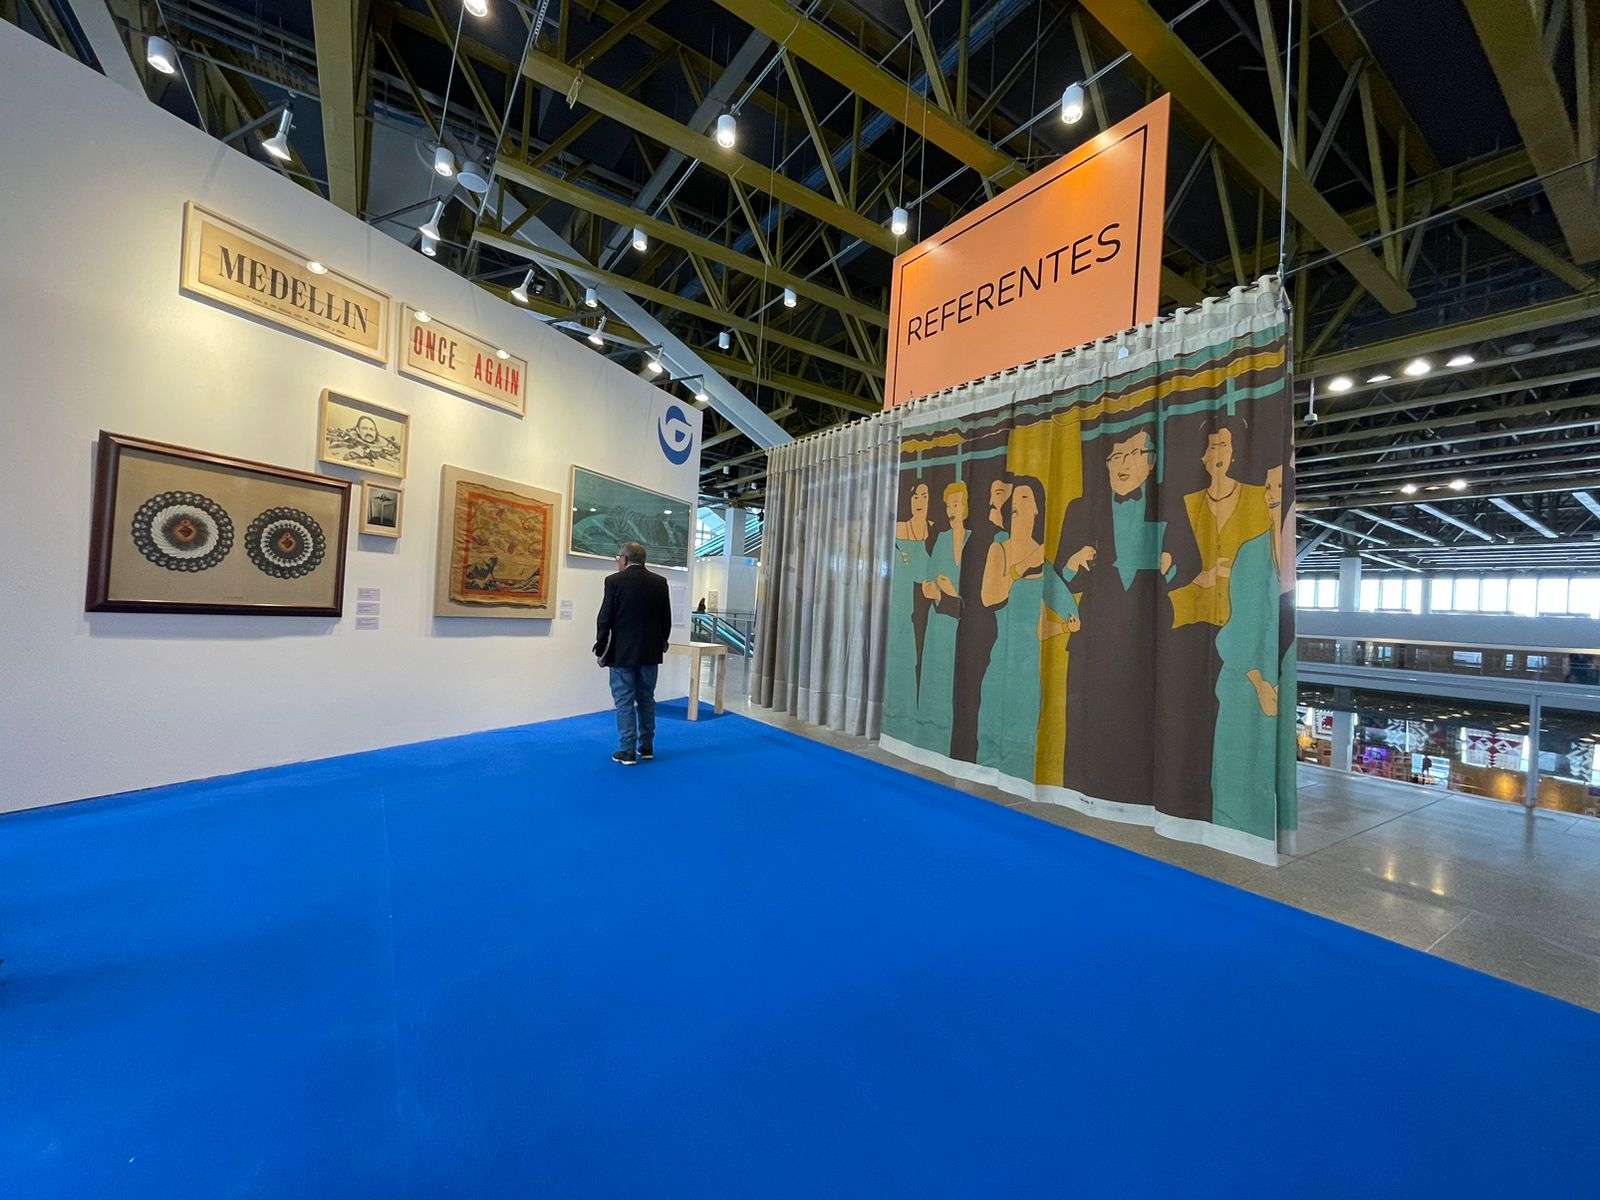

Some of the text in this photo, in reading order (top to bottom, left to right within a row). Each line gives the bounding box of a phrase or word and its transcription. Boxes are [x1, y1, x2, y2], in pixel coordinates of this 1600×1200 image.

[218, 245, 368, 334] MEDELLIN
[907, 222, 1121, 345] REFERENTES
[413, 325, 519, 396] ONCE AGAIN
